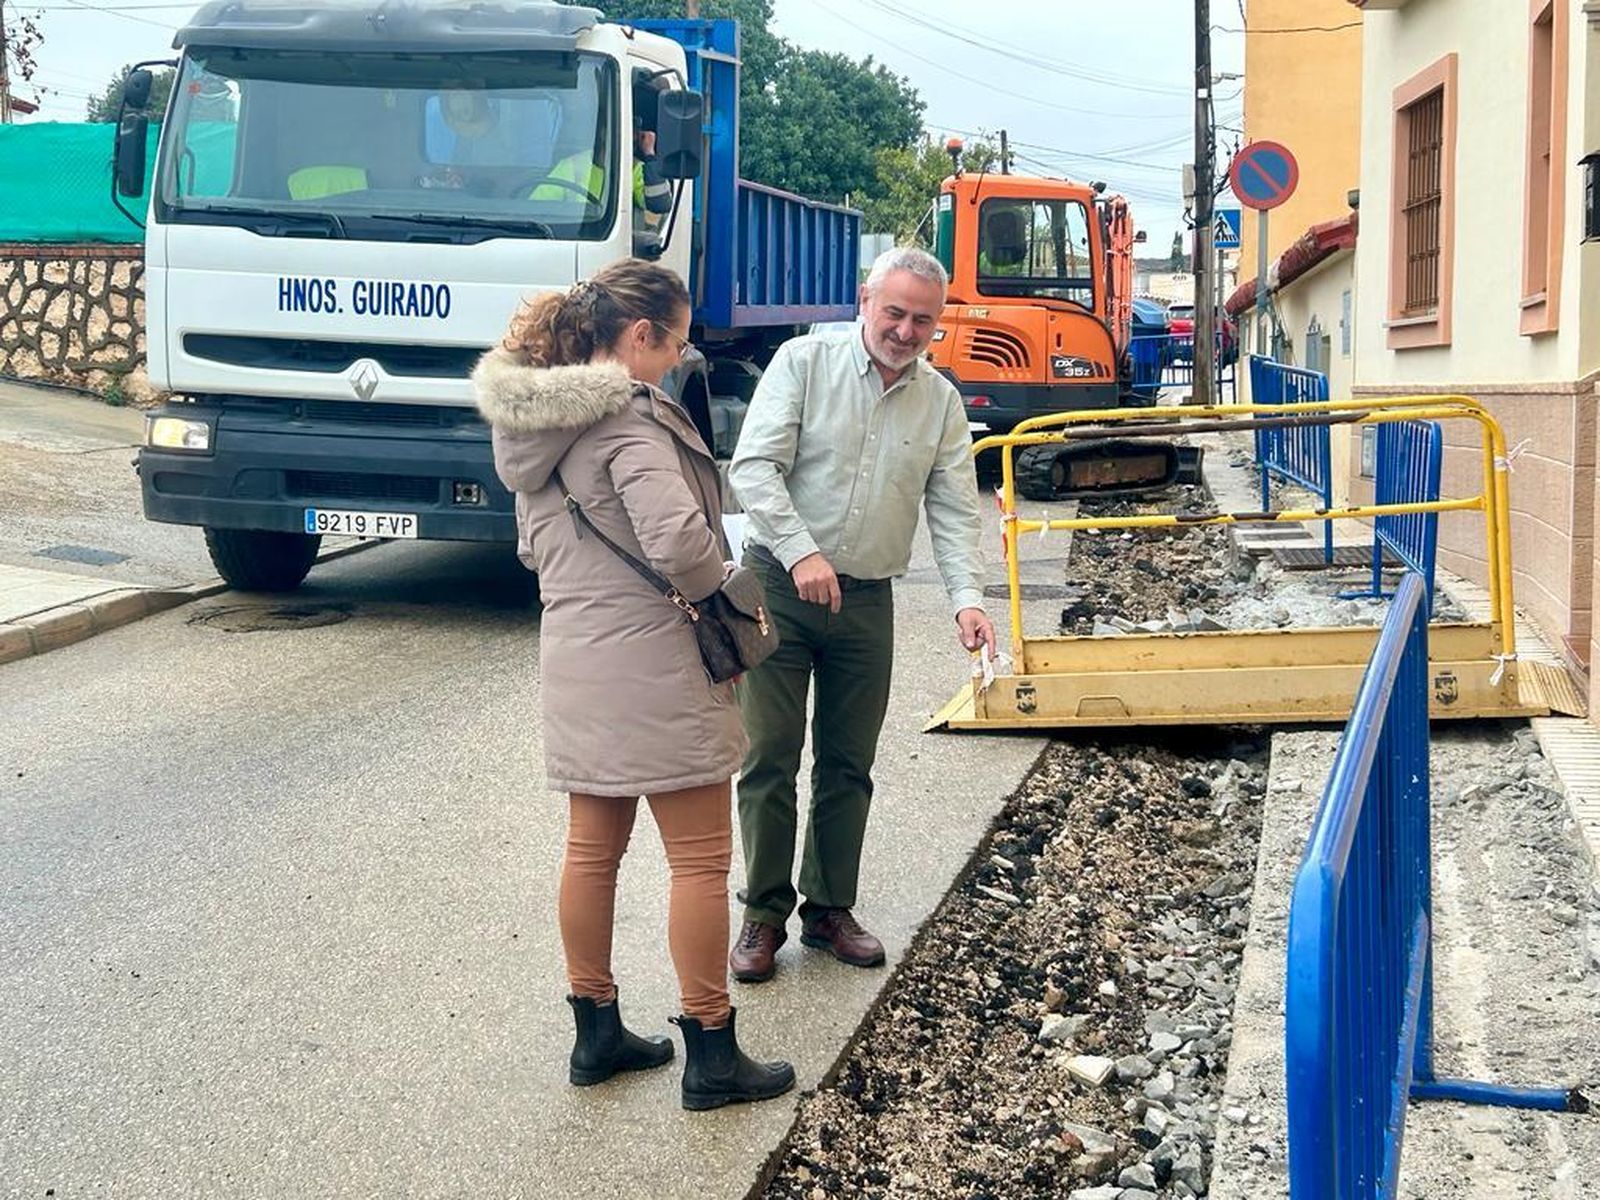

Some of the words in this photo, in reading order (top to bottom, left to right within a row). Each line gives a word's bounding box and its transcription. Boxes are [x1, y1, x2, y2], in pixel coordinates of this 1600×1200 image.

[278, 277, 344, 314] HNOS.
[352, 280, 451, 319] GUIRADO
[1055, 358, 1076, 368] DX
[317, 513, 367, 533] 9219
[376, 516, 413, 535] FVP
